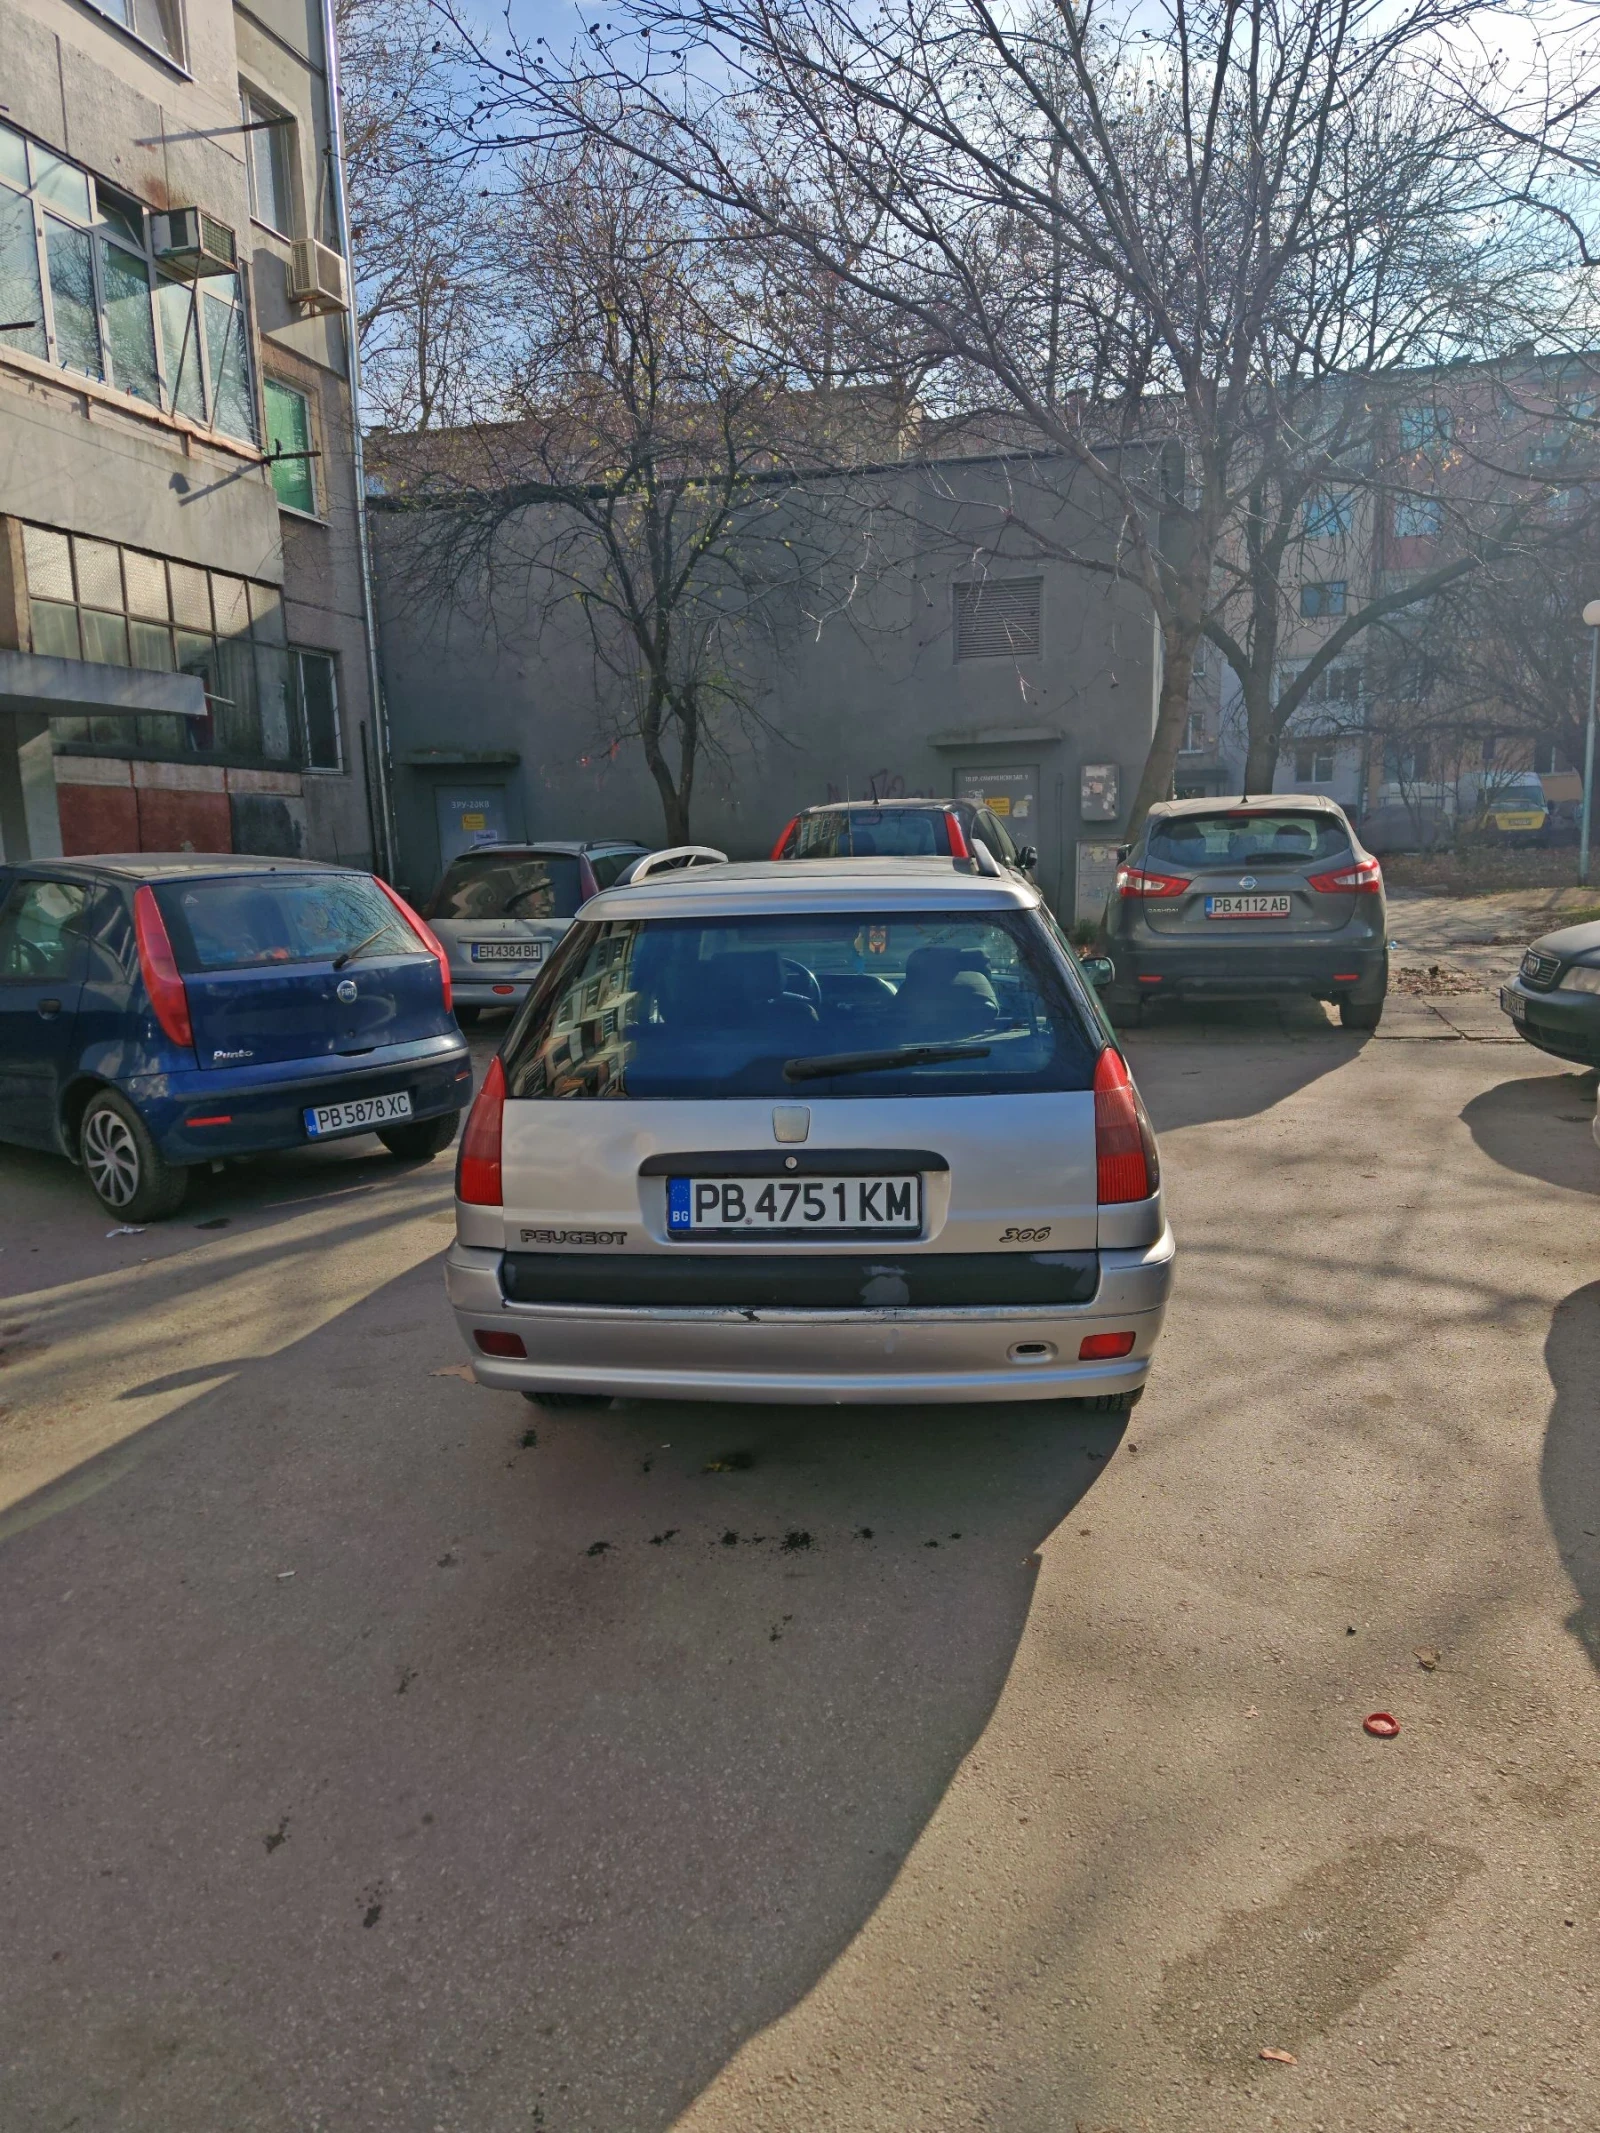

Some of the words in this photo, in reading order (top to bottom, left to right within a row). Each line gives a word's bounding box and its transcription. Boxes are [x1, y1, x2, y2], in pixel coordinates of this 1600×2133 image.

[340, 987, 355, 997] FIAT
[213, 1049, 254, 1060] Punto
[672, 1211, 689, 1222] BG
[520, 1229, 628, 1245] PEUGEOT
[998, 1226, 1052, 1243] 306
